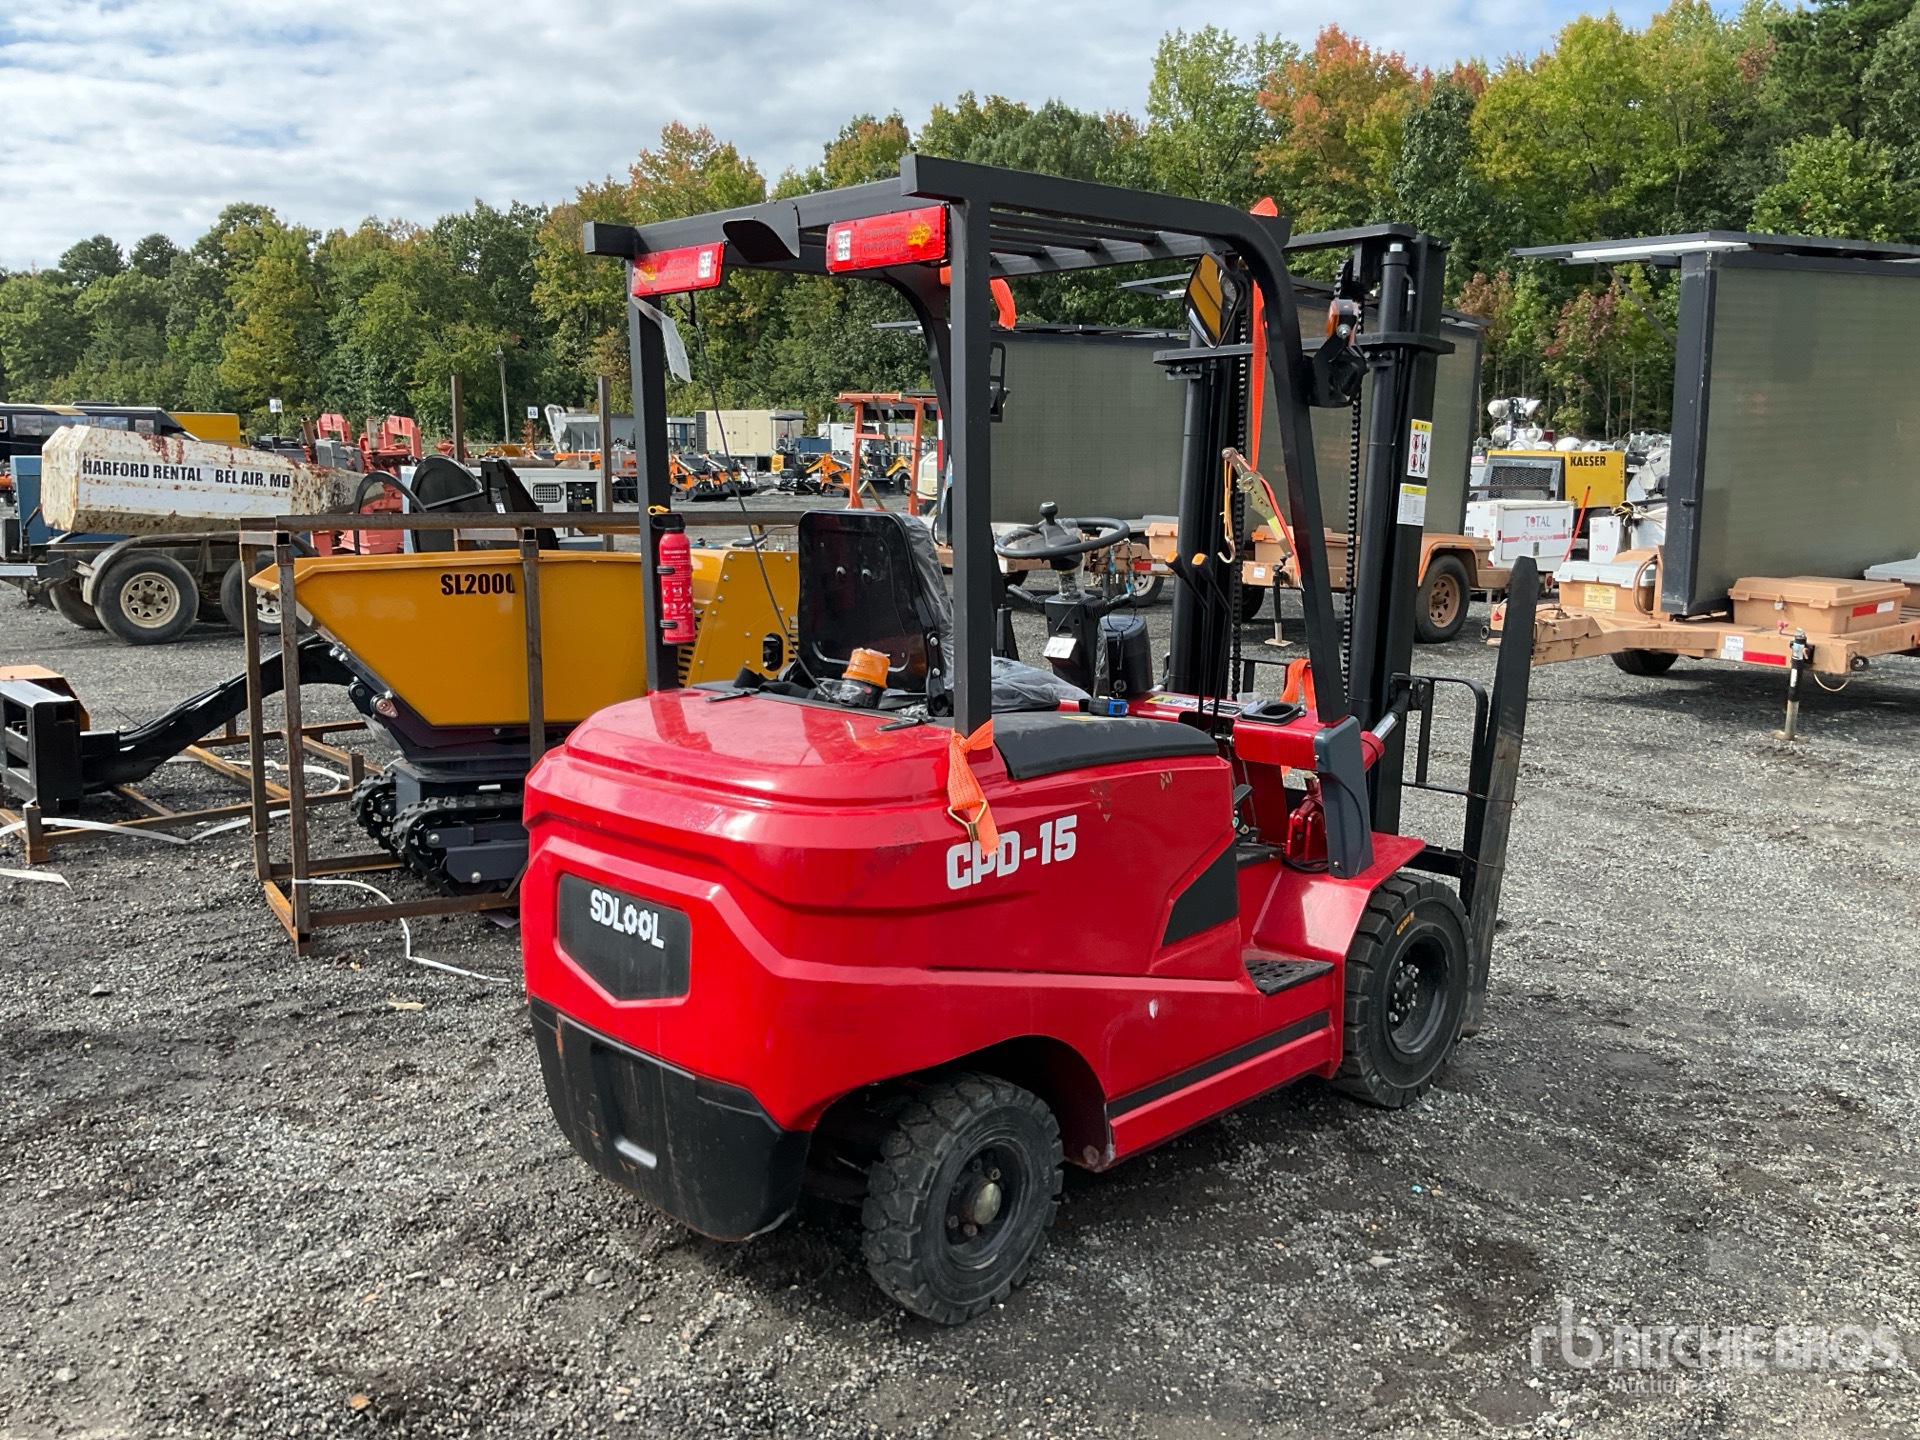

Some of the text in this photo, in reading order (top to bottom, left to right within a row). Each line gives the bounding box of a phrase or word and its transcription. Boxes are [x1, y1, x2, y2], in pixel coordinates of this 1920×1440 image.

[82, 459, 149, 478] HARFORD
[153, 463, 202, 482] RENTAL
[215, 469, 238, 484] BEL
[241, 471, 266, 487] AIR,
[1570, 456, 1606, 467] KAESER
[1524, 515, 1551, 528] TOTAL
[947, 814, 1077, 890] CPD-15
[590, 888, 664, 949] SDLOOL
